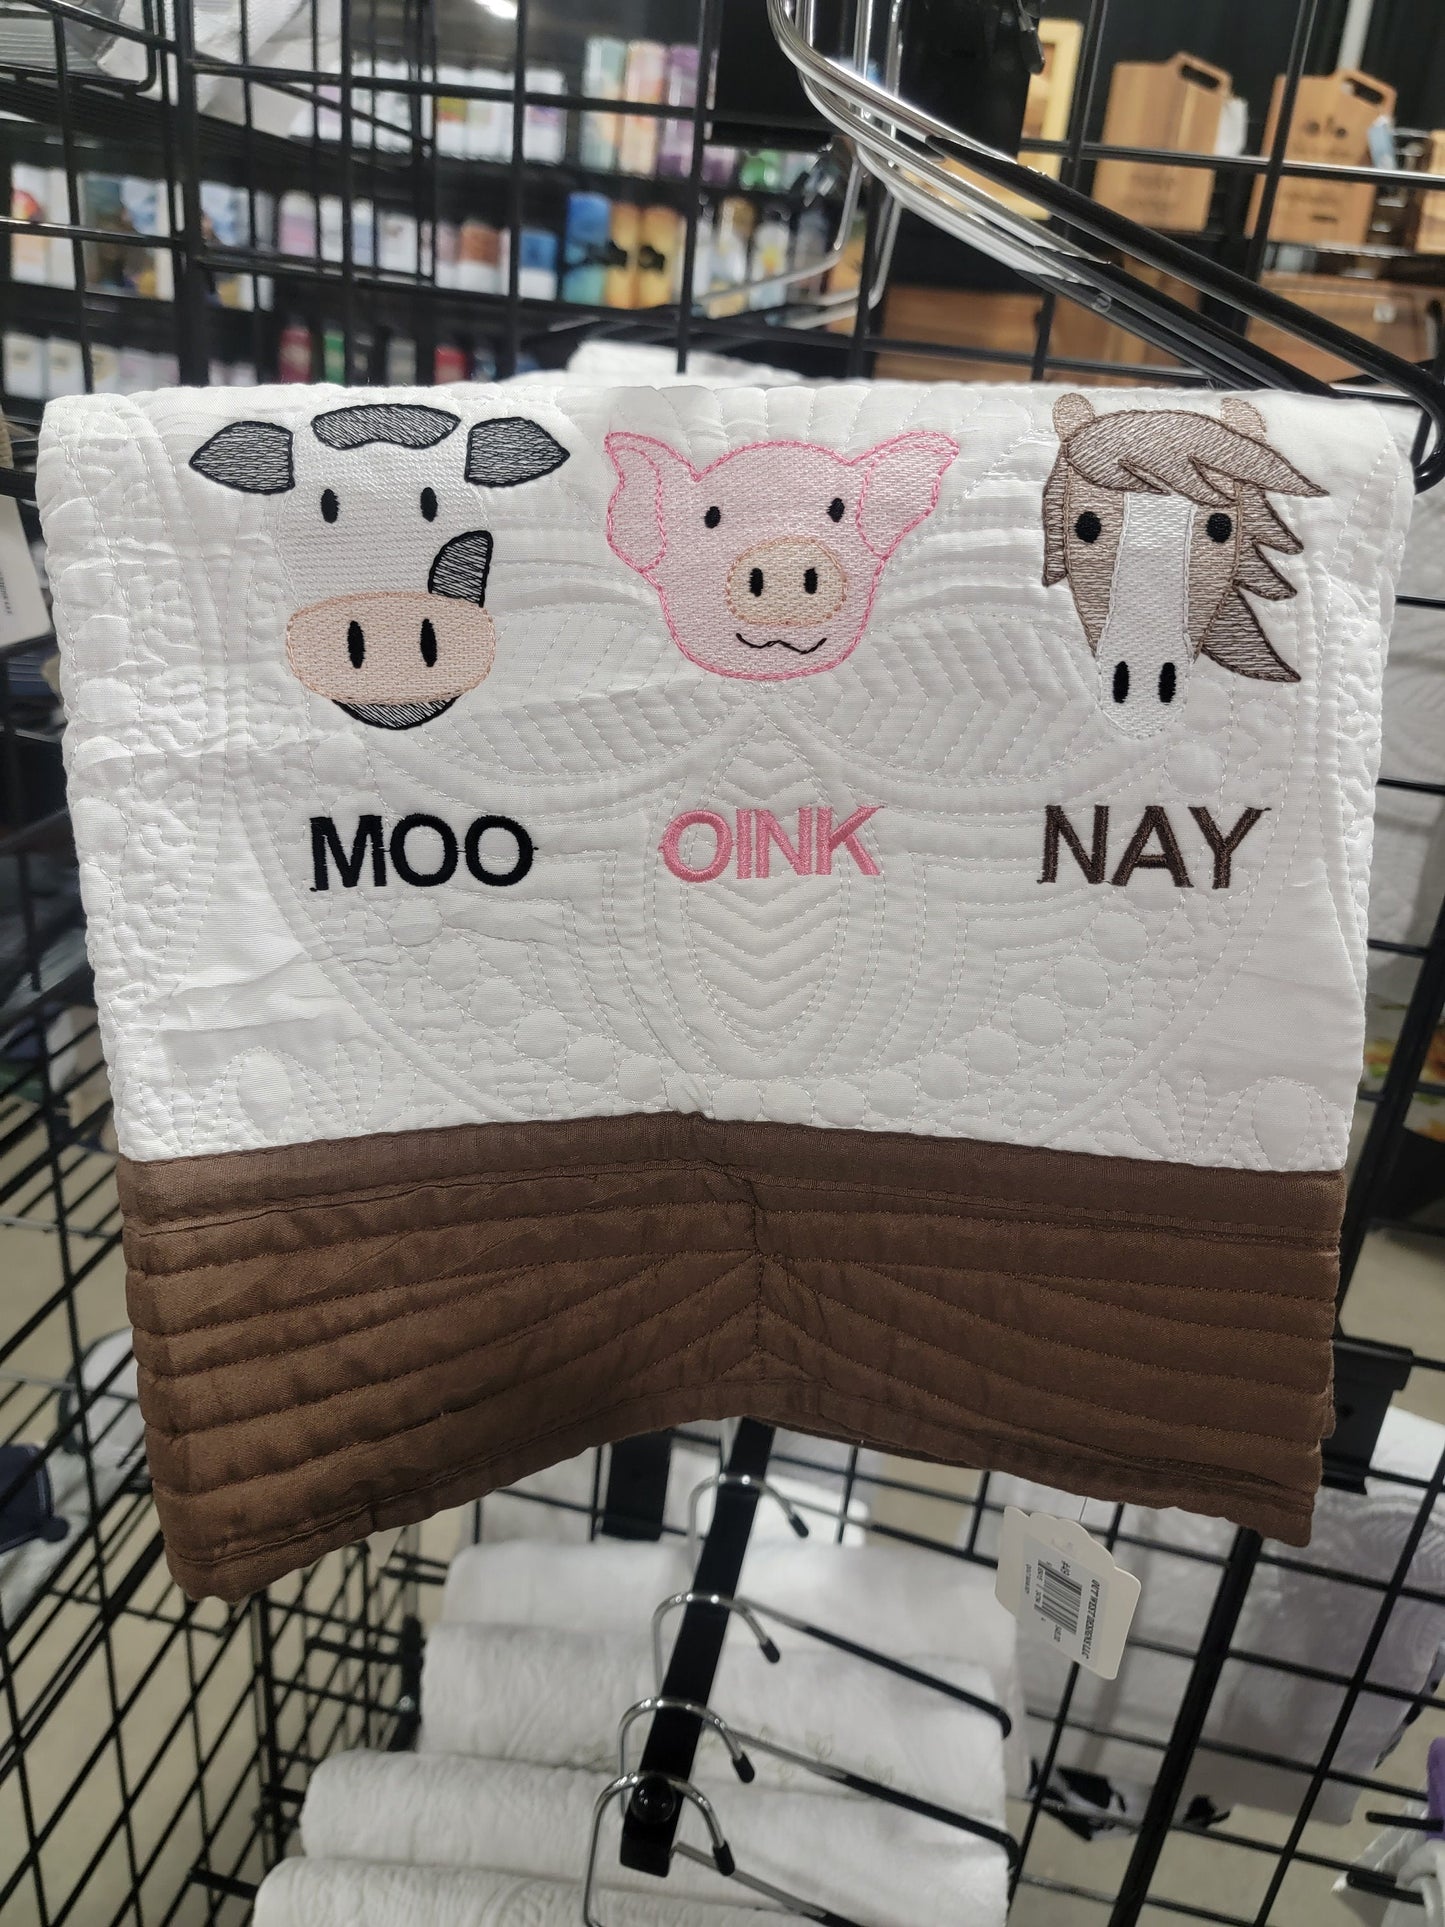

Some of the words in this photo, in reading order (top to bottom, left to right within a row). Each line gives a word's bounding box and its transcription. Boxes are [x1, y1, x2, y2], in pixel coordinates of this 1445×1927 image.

[310, 813, 535, 891] MOO
[659, 806, 884, 883] OINK
[1039, 805, 1269, 889] NAY
